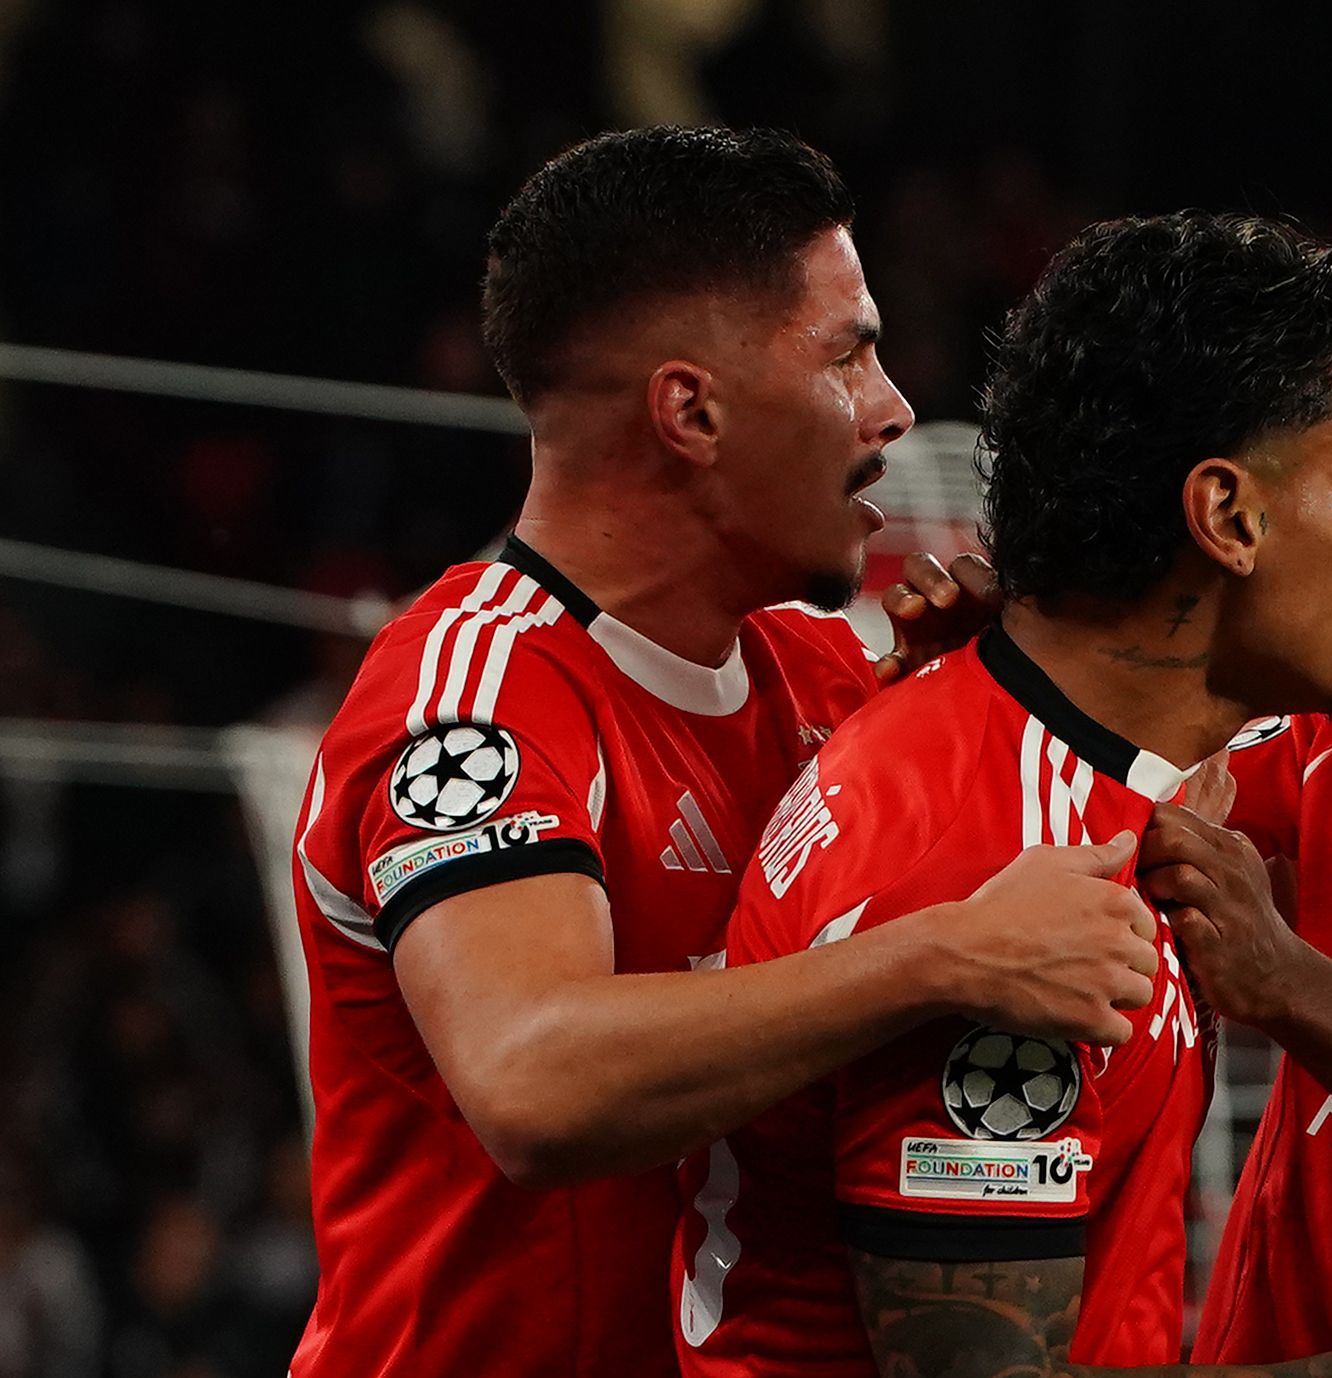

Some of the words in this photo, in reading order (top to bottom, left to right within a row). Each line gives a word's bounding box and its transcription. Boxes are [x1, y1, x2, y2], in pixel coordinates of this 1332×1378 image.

[375, 837, 479, 895] FOUNDATION
[907, 1142, 938, 1153] UEFA
[906, 1160, 1029, 1178] FOUNDATION
[1032, 1154, 1073, 1184] 10
[982, 1184, 995, 1197] for
[996, 1185, 1029, 1196] children
